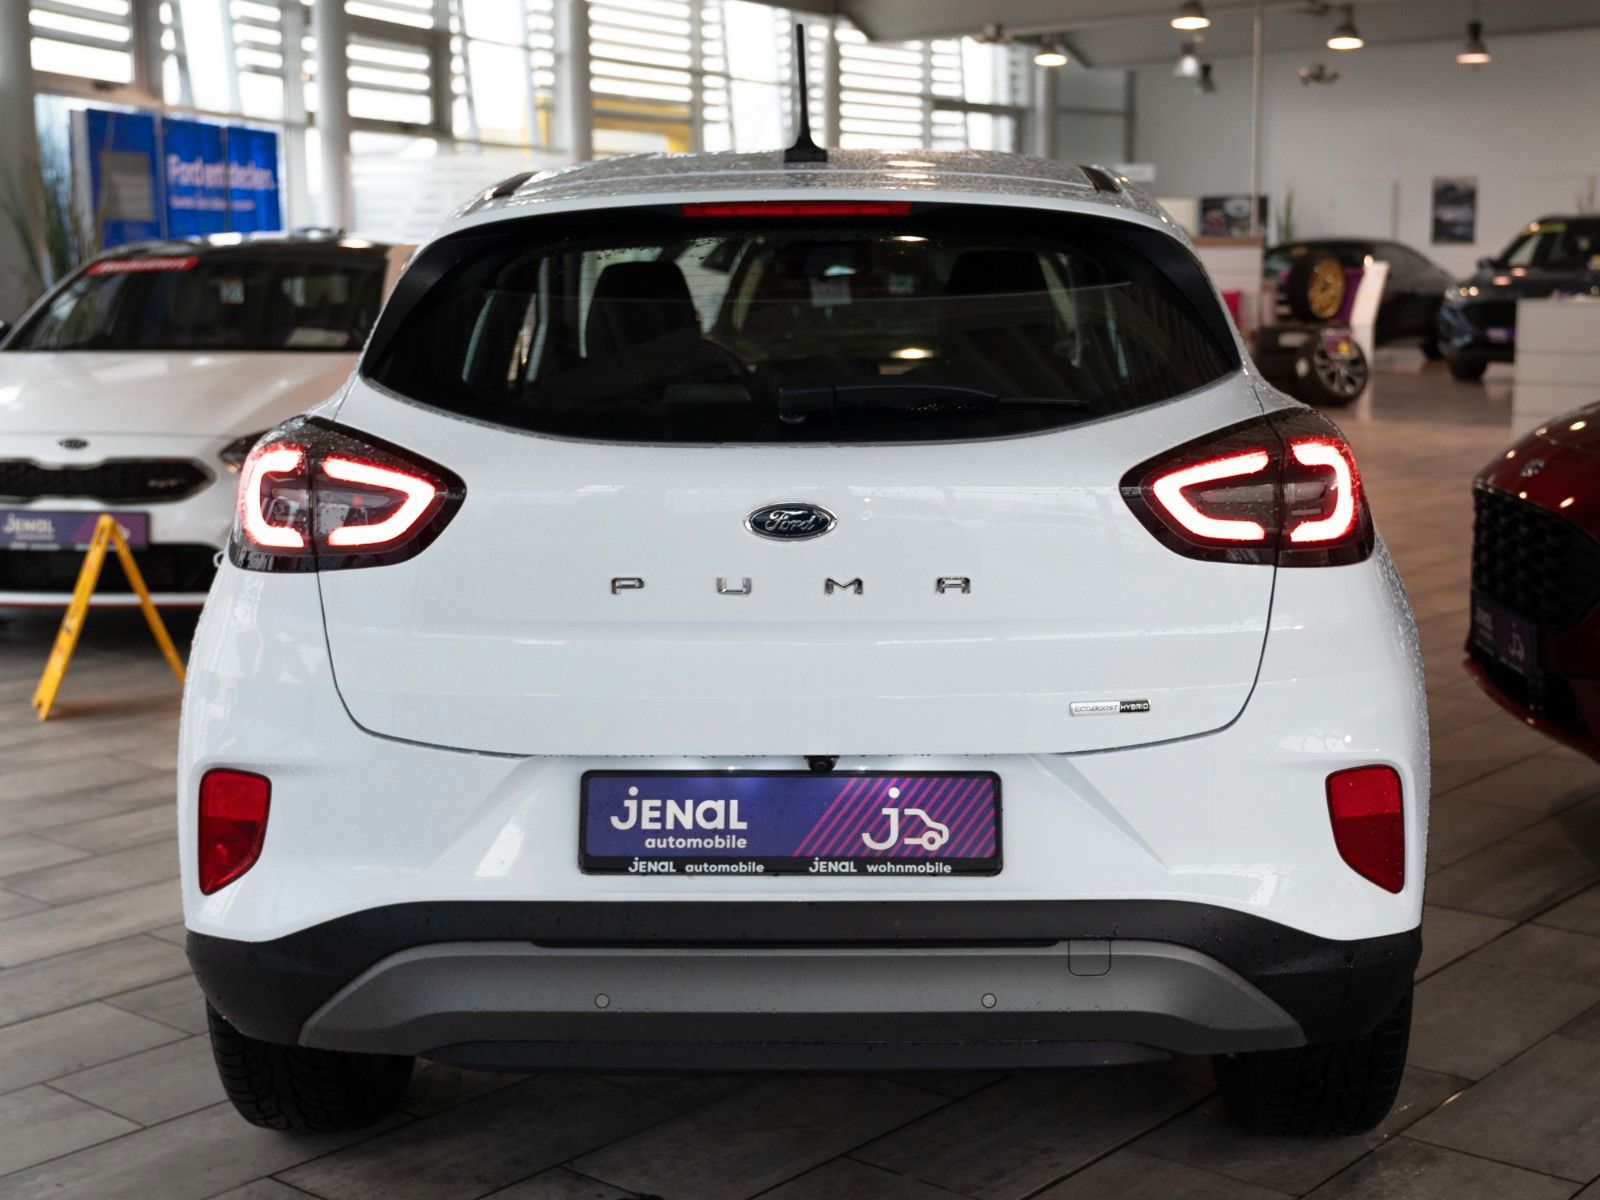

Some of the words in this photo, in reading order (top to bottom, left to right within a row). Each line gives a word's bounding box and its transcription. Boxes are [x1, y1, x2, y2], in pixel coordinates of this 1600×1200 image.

[764, 510, 817, 531] Ford
[611, 577, 971, 595] PUMA
[1120, 702, 1149, 711] HYBRID
[644, 835, 748, 849] automobile
[685, 862, 765, 873] automobile
[866, 862, 952, 874] wohnmobile
